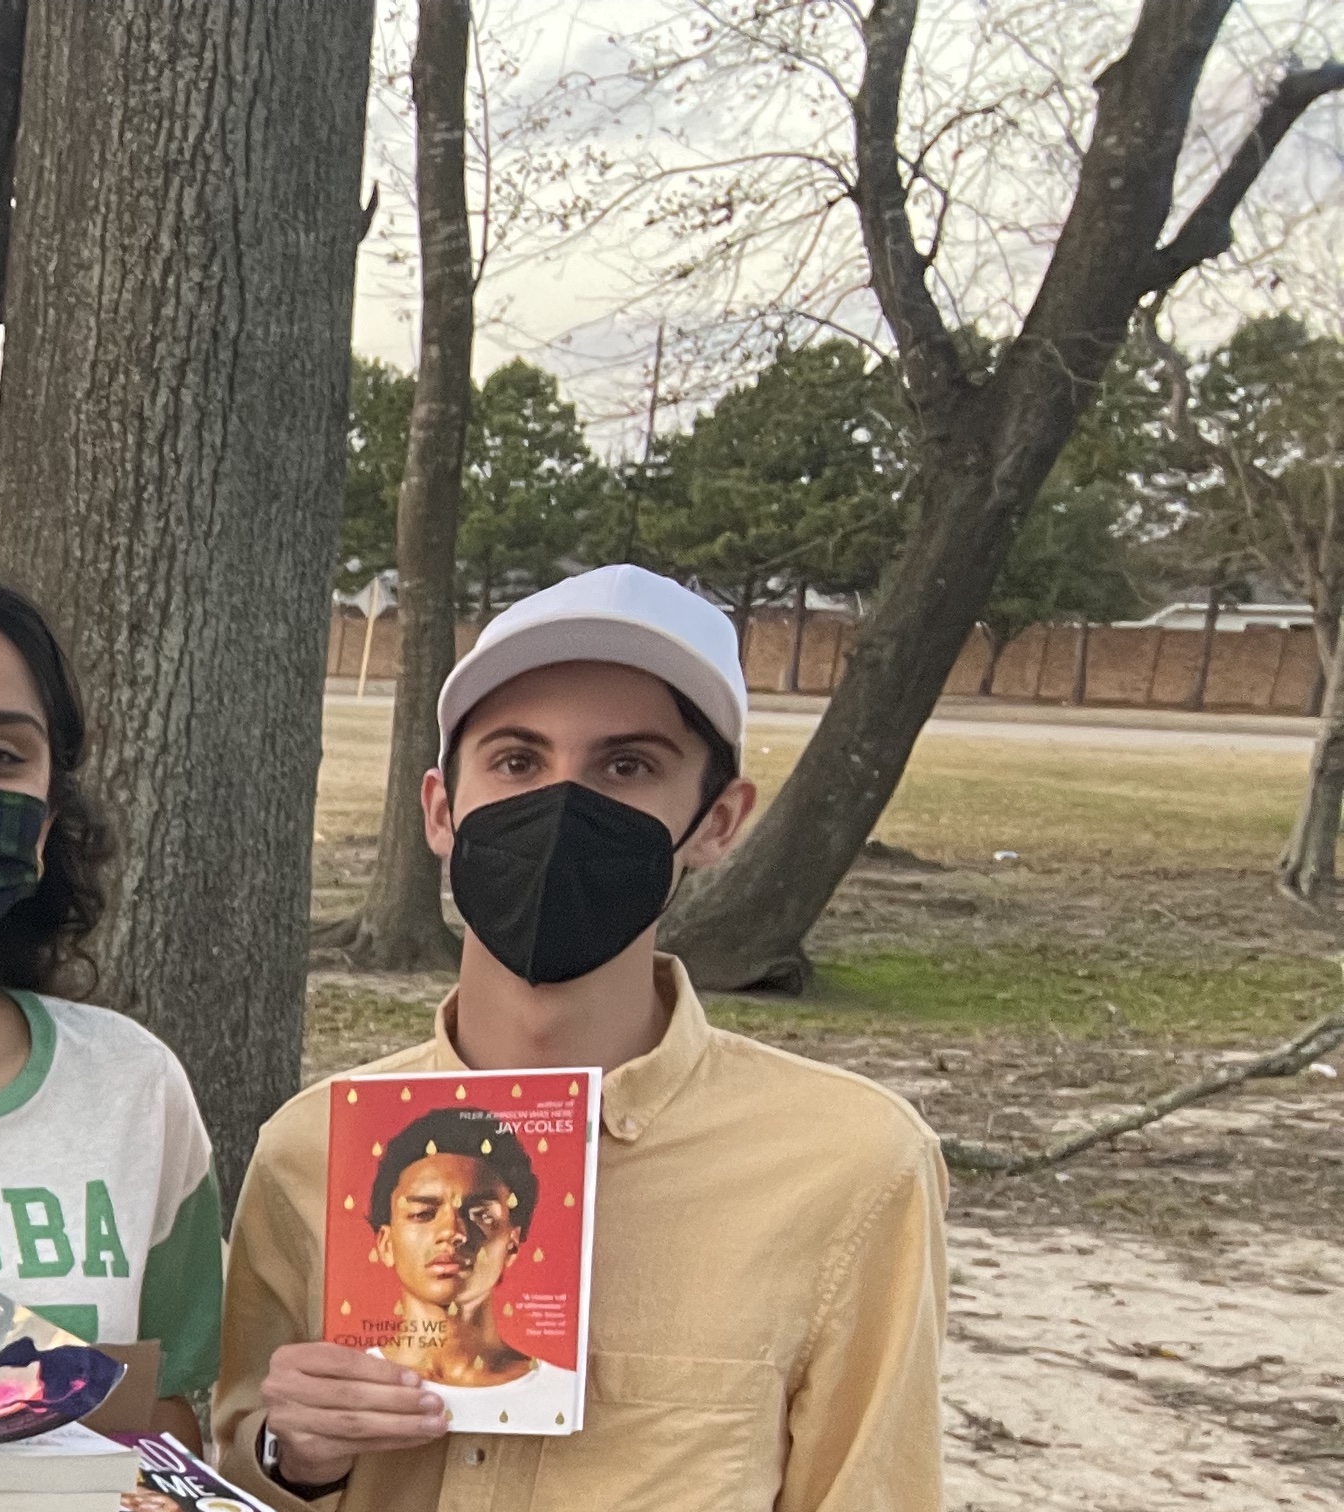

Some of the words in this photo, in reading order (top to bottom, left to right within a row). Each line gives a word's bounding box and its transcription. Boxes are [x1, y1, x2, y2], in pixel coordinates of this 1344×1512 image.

[495, 1121, 522, 1134] JAY
[524, 1120, 574, 1133] COLES
[361, 1320, 418, 1333] THINGS
[422, 1320, 448, 1333] WE
[418, 1335, 448, 1349] SAY
[151, 1473, 216, 1498] ME
